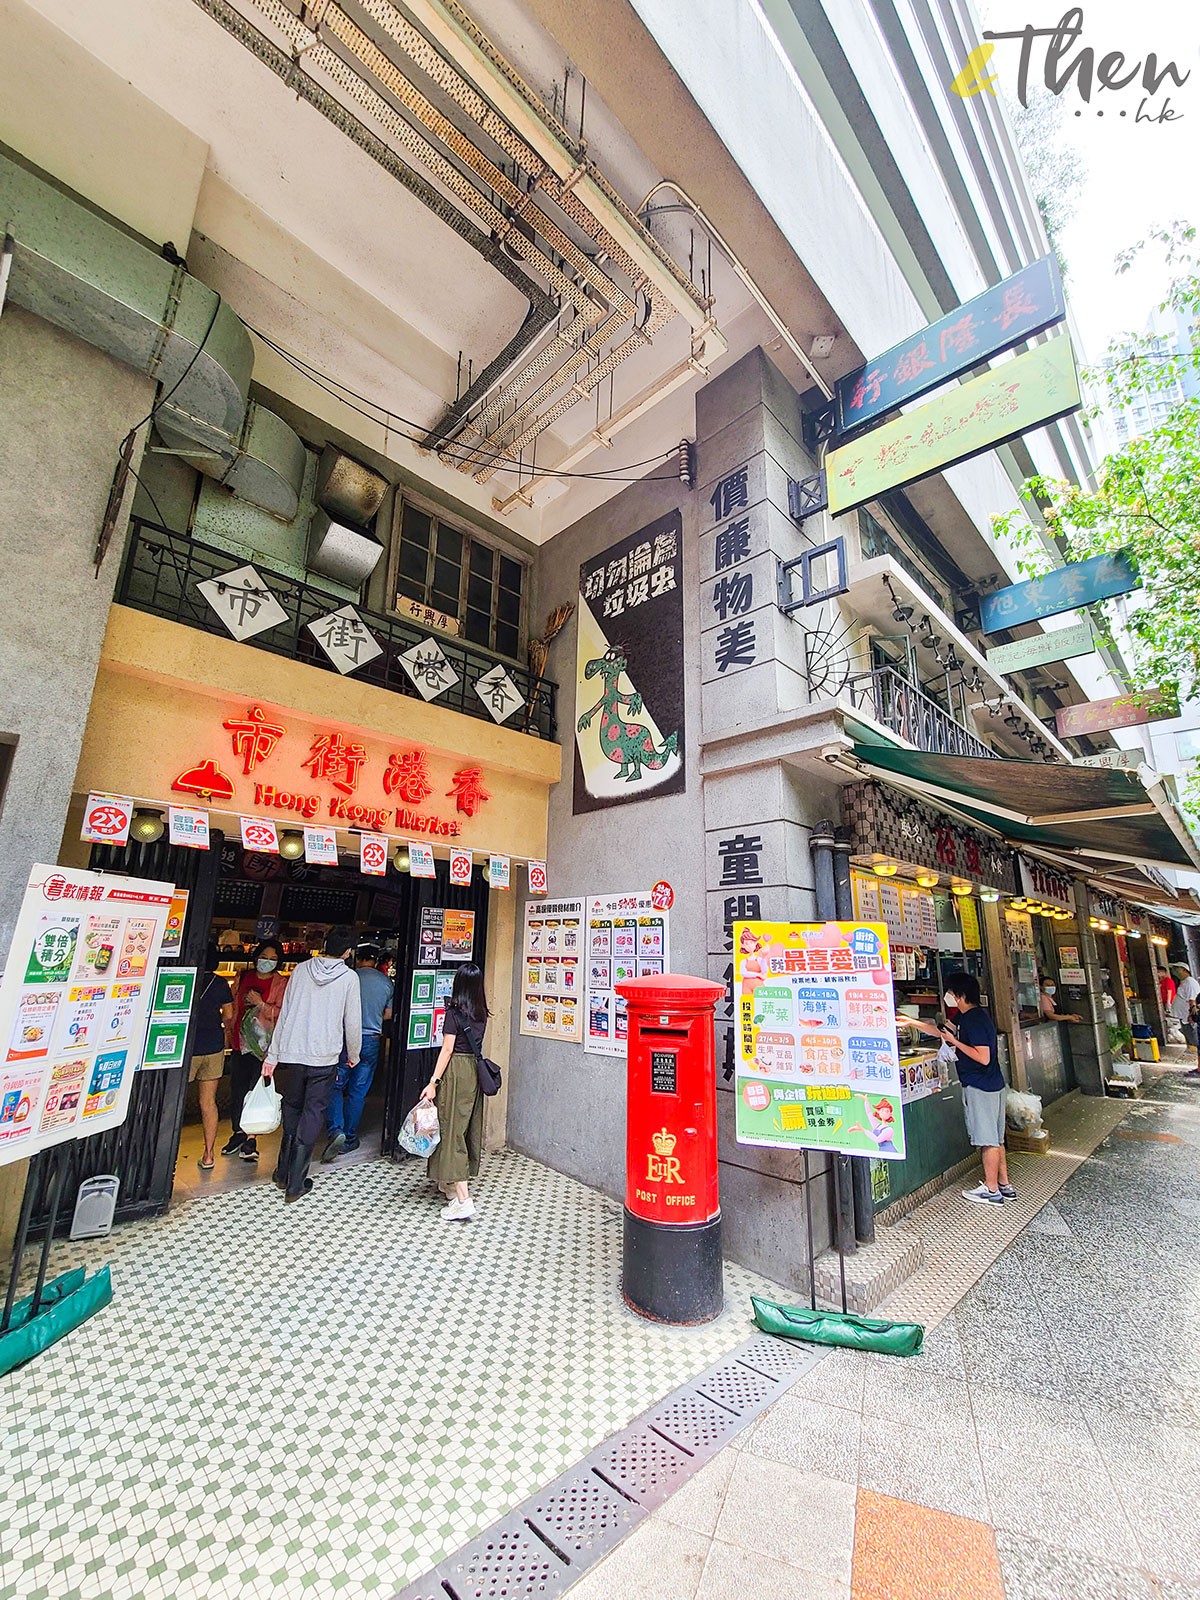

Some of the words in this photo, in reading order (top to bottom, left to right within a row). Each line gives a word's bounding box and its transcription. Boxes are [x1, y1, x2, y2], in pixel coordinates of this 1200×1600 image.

[710, 465, 756, 672] 價廉物美
[254, 783, 321, 818] Hong
[330, 796, 392, 828] Kong
[44, 934, 68, 948] 雙倍
[40, 949, 65, 962] 積分
[718, 834, 763, 1083] 童叟
[771, 949, 881, 972] 我最喜愛檔口
[762, 1001, 789, 1021] 蔬菜
[849, 1002, 873, 1014] 鮮肉
[827, 1015, 838, 1026] 魚
[742, 1002, 753, 1054] 投票時間表
[758, 1046, 774, 1054] 生果
[805, 1048, 828, 1060] 食店
[852, 1051, 877, 1063] 乾貨
[866, 1066, 892, 1079] 其他
[808, 1118, 835, 1127] 現金券
[636, 1188, 657, 1203] POST
[666, 1194, 696, 1206] OFFICE
